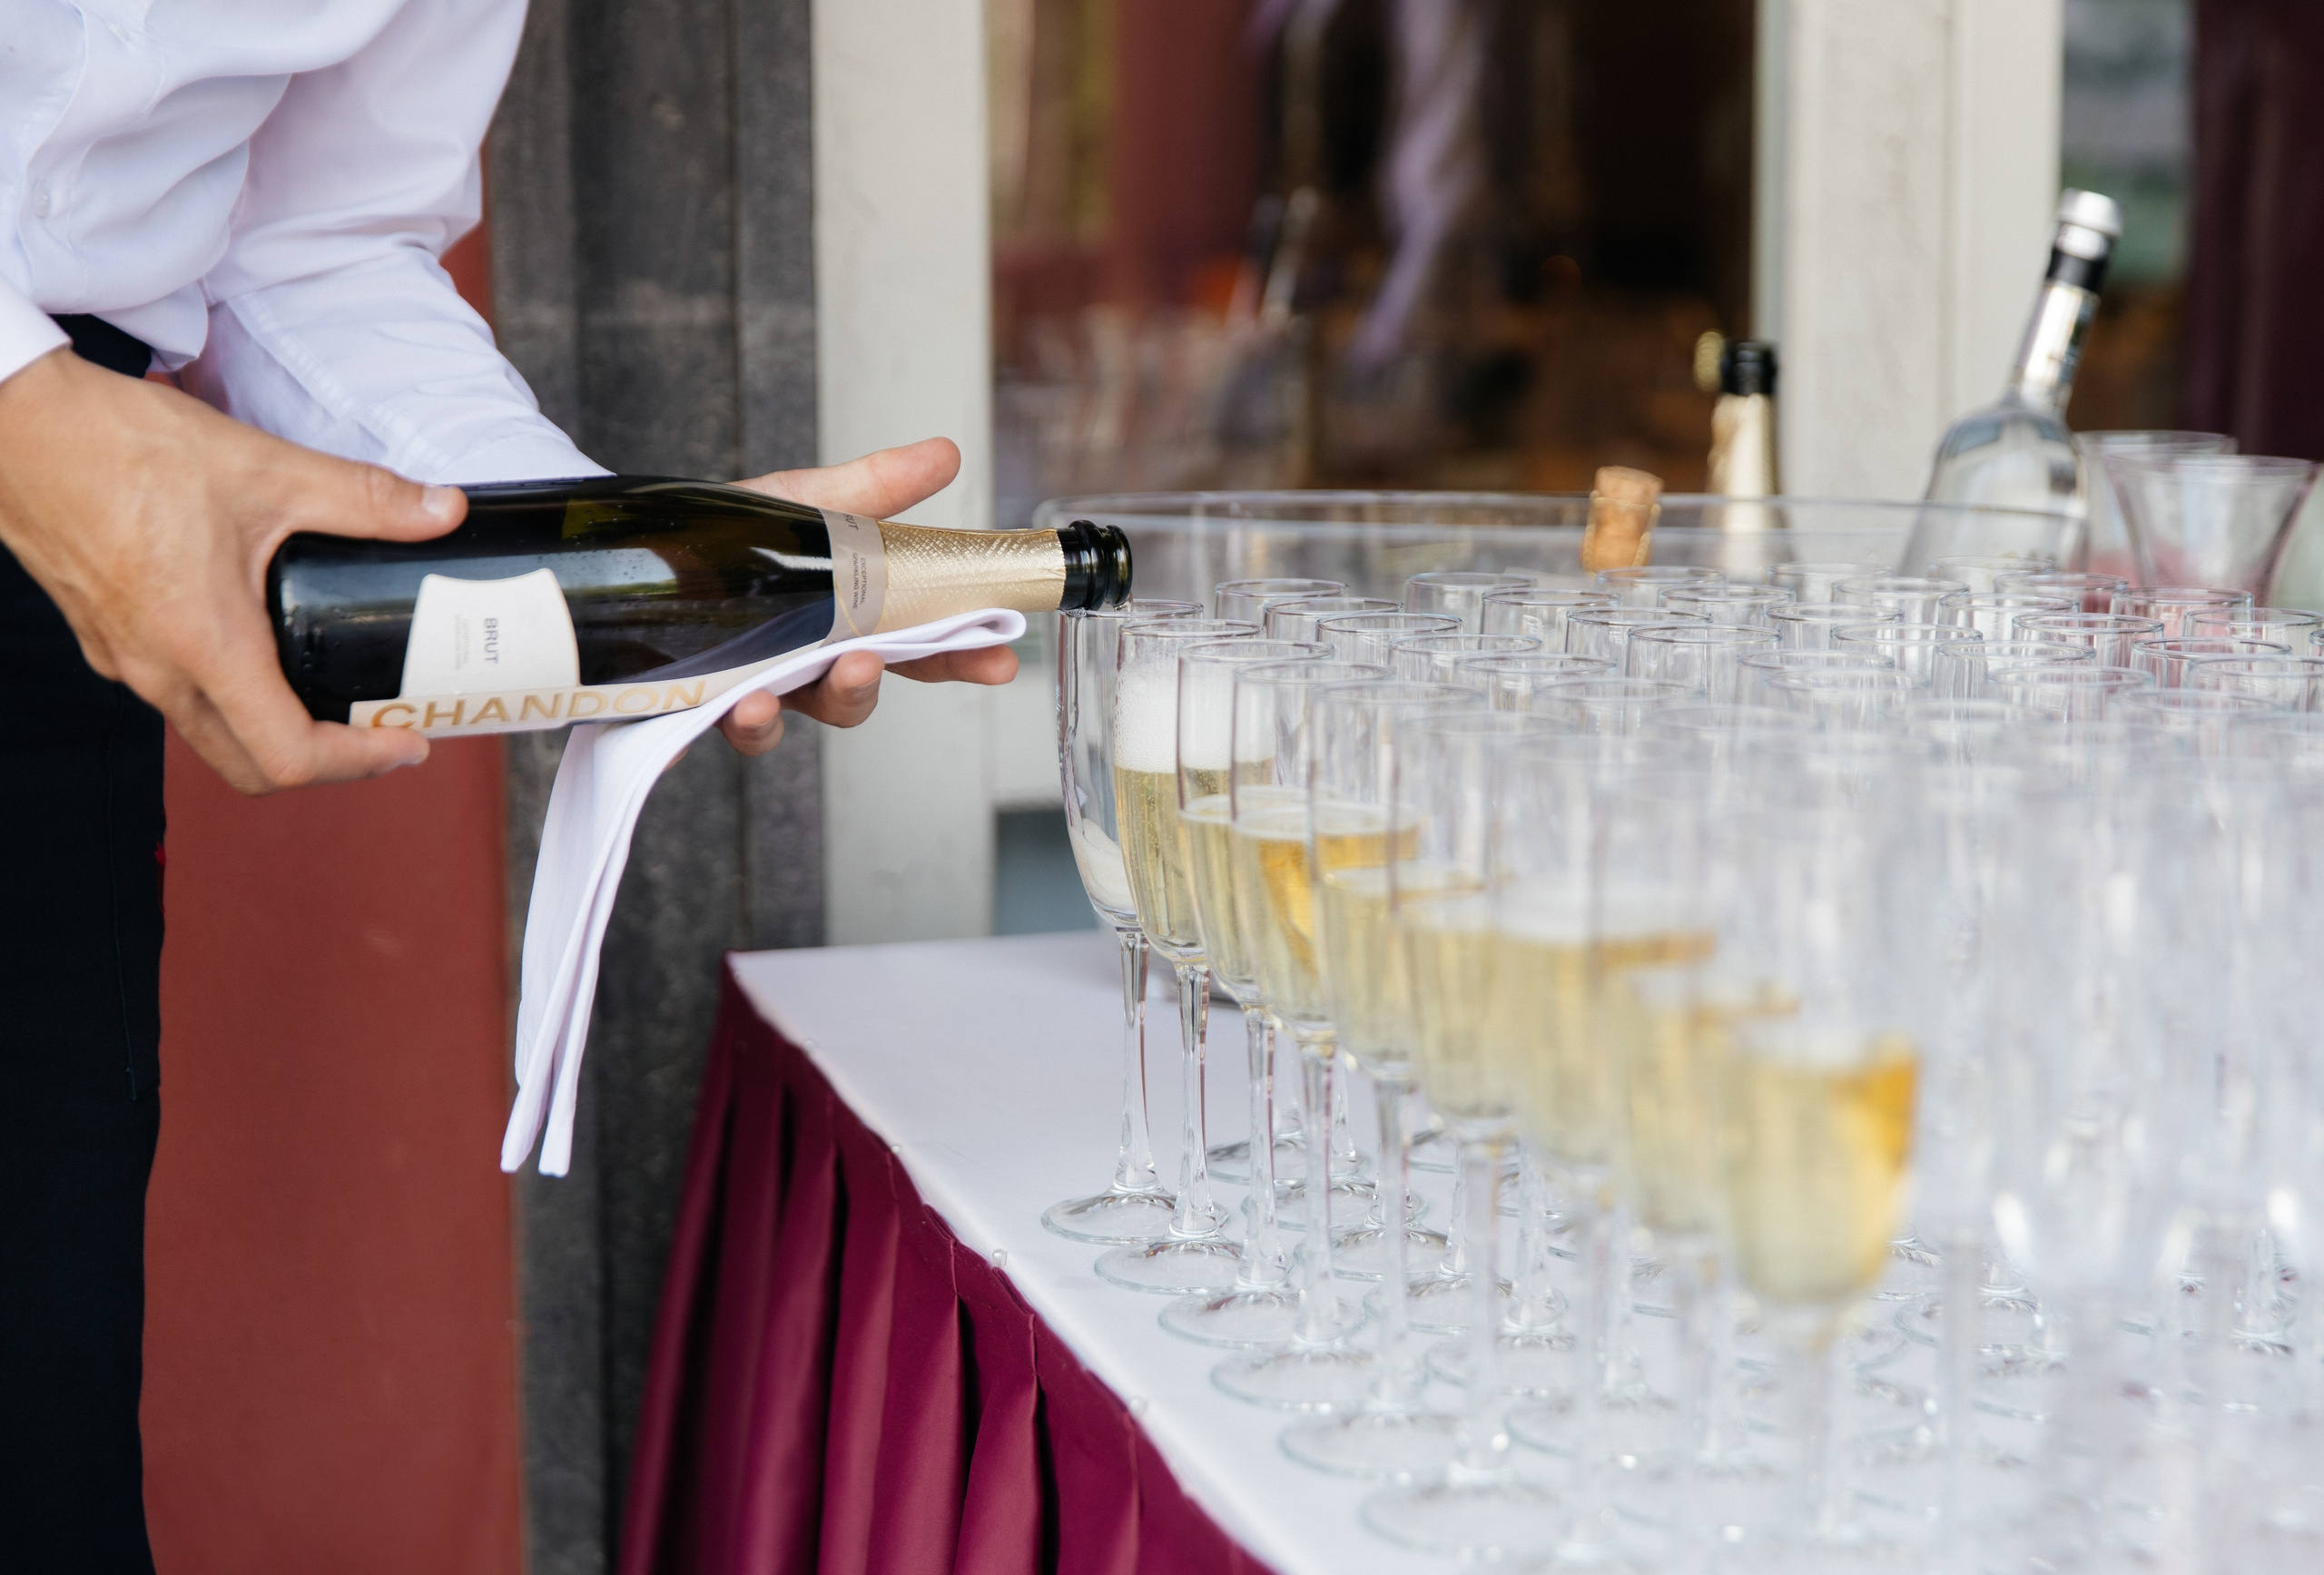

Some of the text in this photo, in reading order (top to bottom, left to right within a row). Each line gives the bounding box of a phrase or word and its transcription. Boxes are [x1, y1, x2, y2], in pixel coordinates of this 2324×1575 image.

[842, 513, 859, 531] RUT
[852, 552, 860, 610] SPARKLING WINE
[860, 556, 868, 605] EXCEPTIONAL
[484, 617, 498, 664] BRUT
[371, 680, 706, 728] CHANDON
